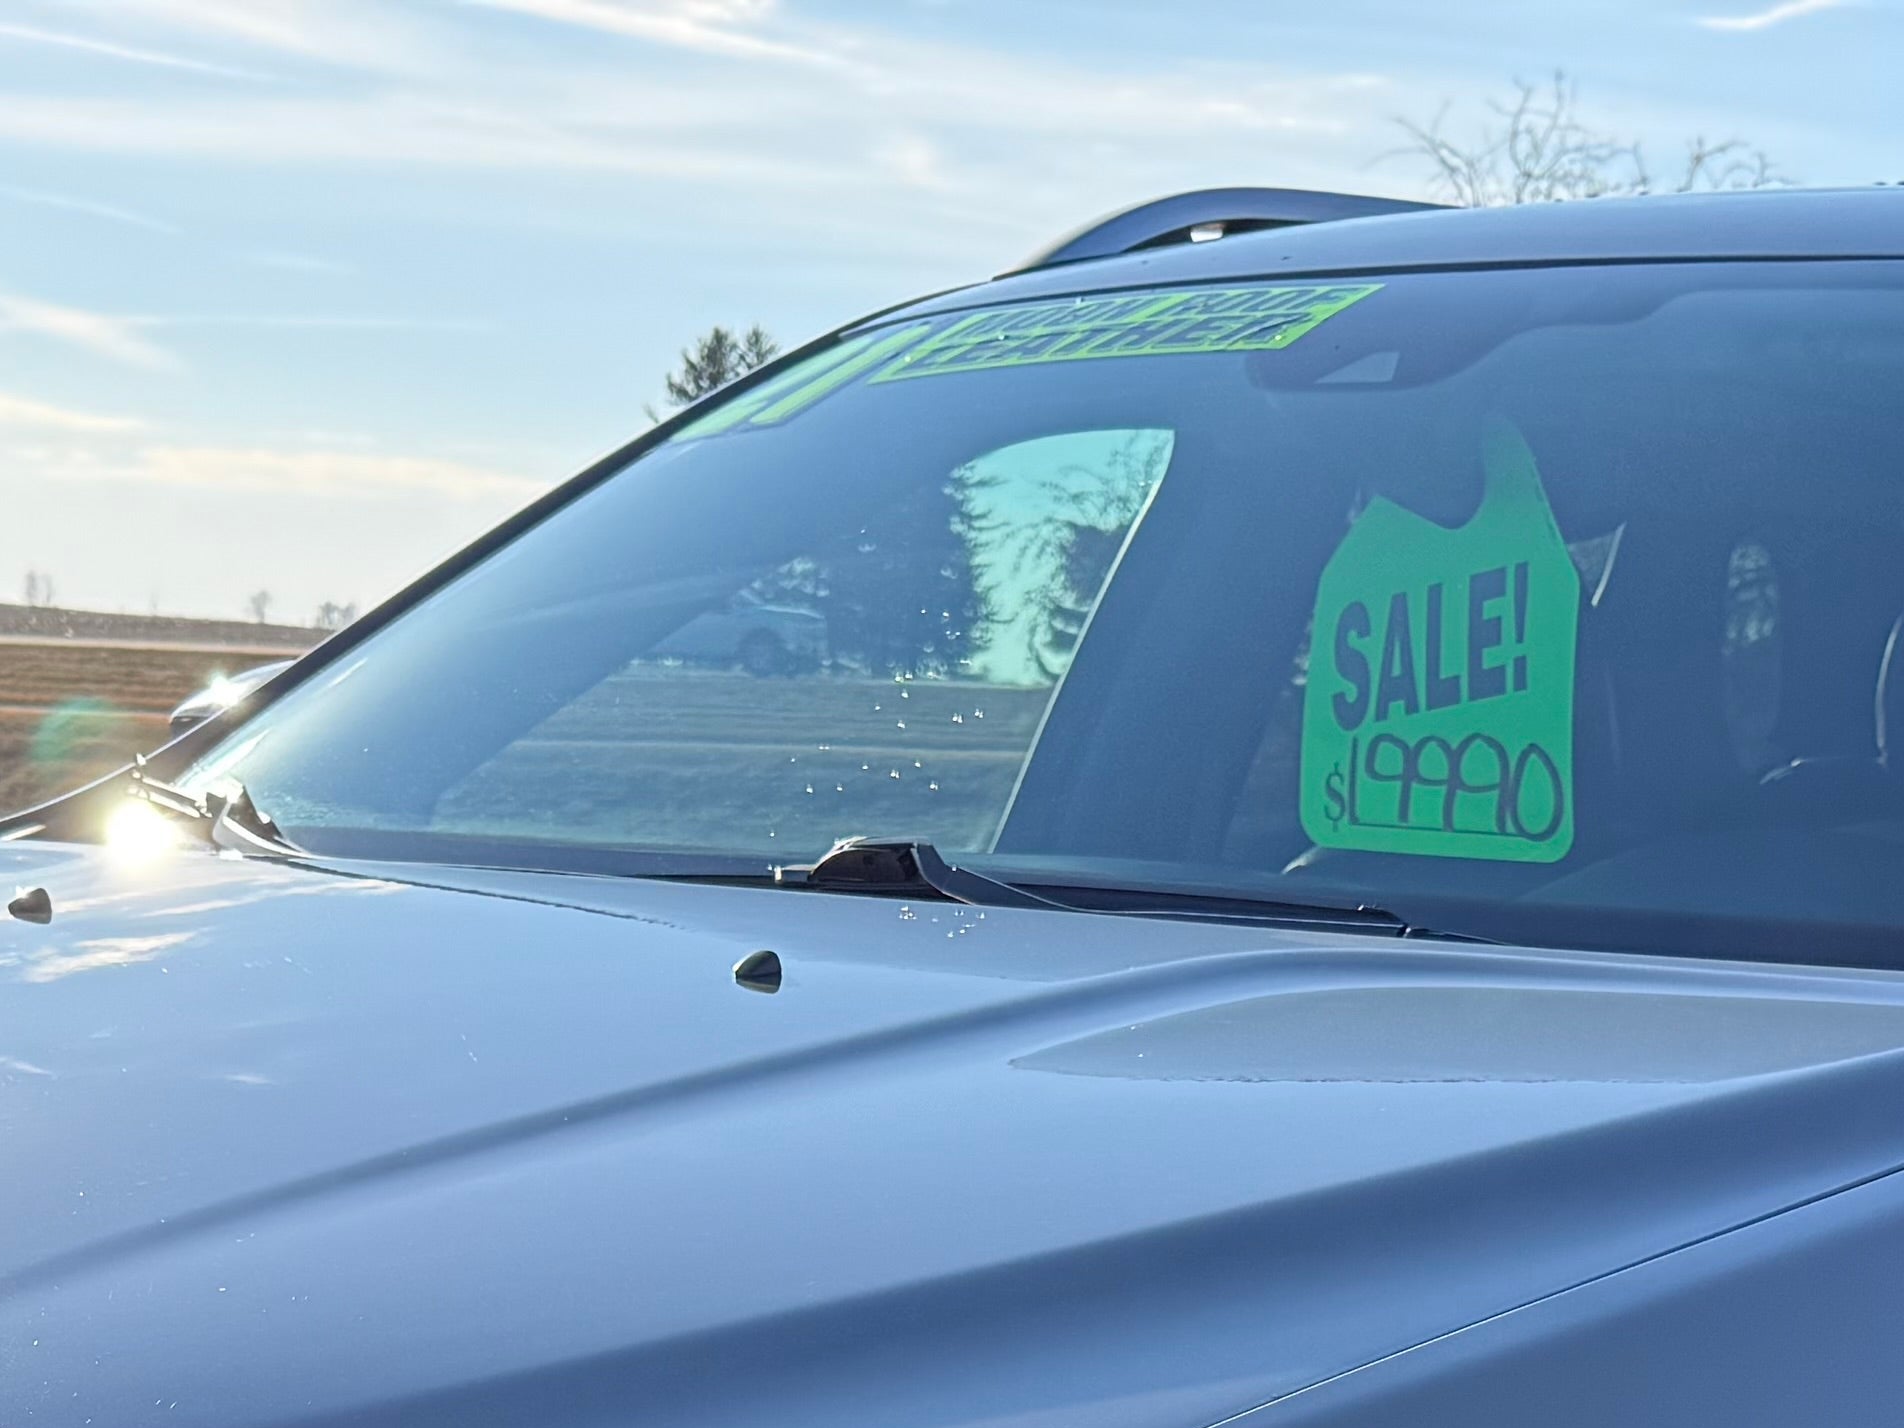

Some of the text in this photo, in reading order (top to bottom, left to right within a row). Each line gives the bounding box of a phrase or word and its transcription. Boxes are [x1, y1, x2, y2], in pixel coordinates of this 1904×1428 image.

[1137, 286, 1372, 323] ROOF
[892, 310, 1316, 376] LEATHER
[1330, 560, 1529, 732] SALE!
